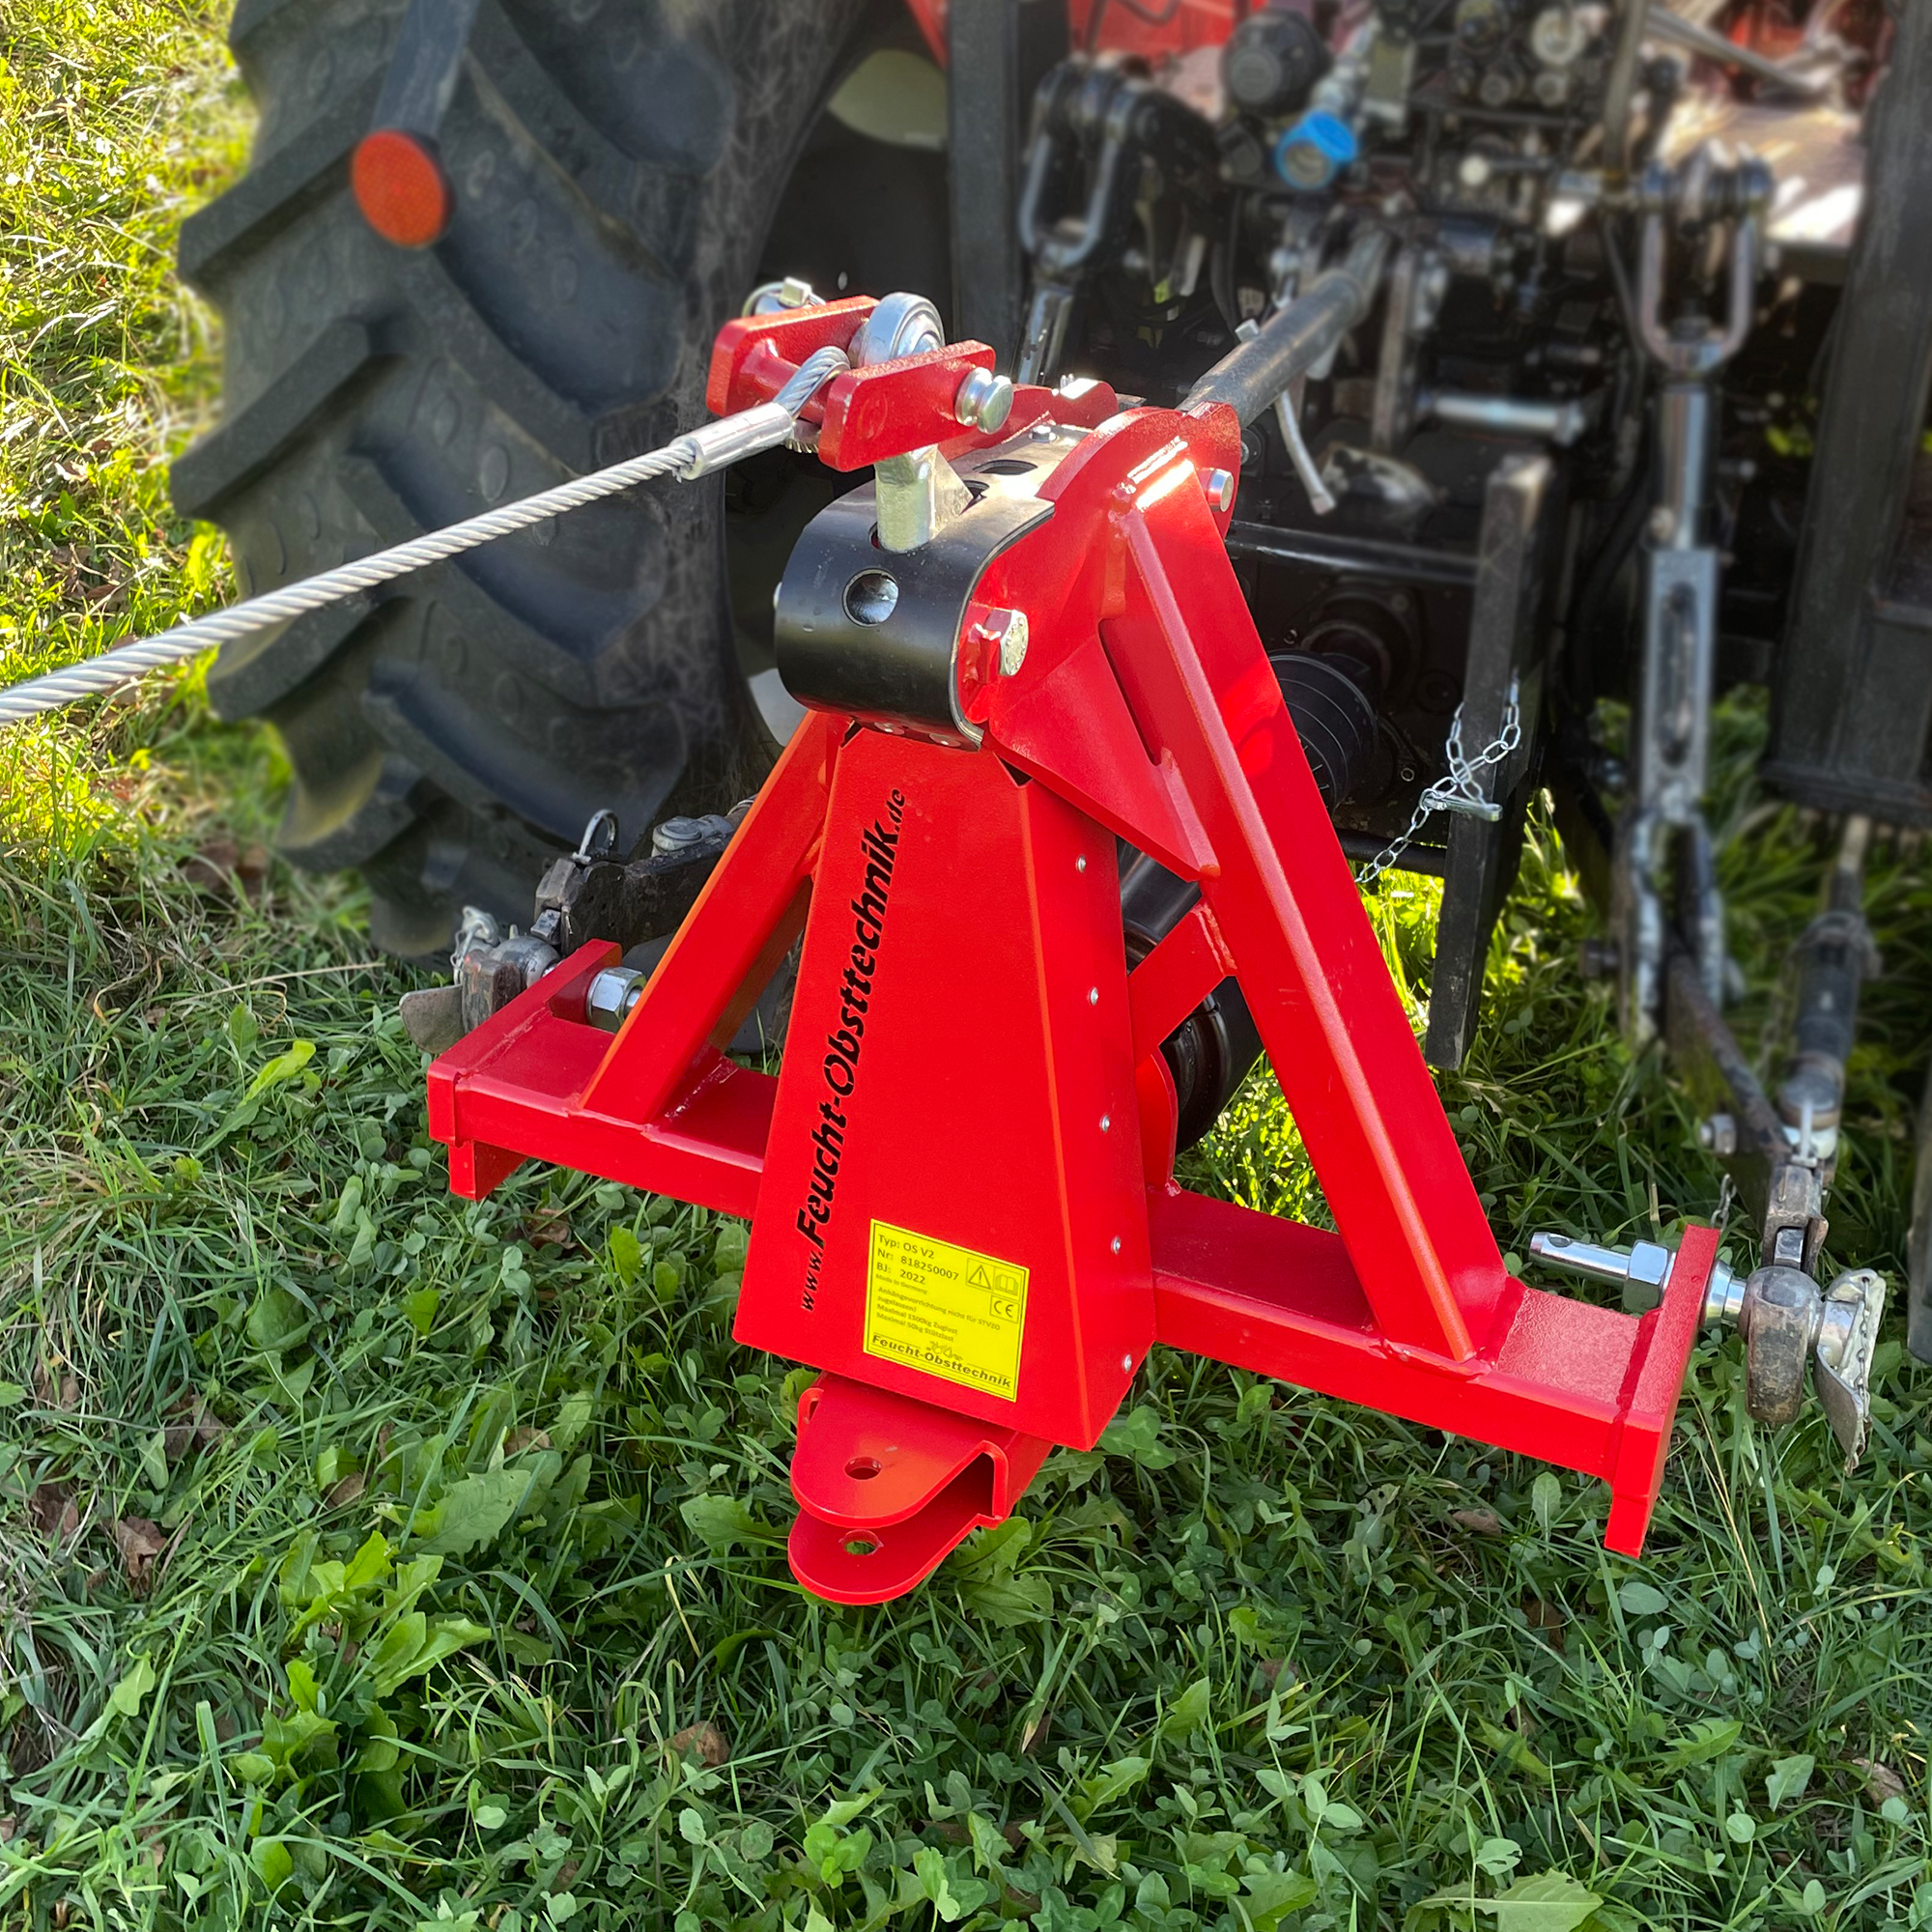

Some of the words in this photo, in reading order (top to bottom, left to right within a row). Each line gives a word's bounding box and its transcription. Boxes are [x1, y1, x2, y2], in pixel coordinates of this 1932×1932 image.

[878, 1234, 899, 1248] Typ:
[903, 1242, 918, 1254] OS
[921, 1247, 934, 1259] V2
[877, 1262, 891, 1273] BJ:
[900, 1269, 925, 1285] 2022
[878, 1248, 894, 1261] Nr:
[900, 1256, 959, 1280] 818250007
[876, 1312, 906, 1326] Maximal
[877, 1303, 907, 1318] Maximal
[948, 1309, 965, 1320] nicht
[993, 1300, 1014, 1319] CE
[872, 1334, 1011, 1388] Feucht-Obsttechnik
